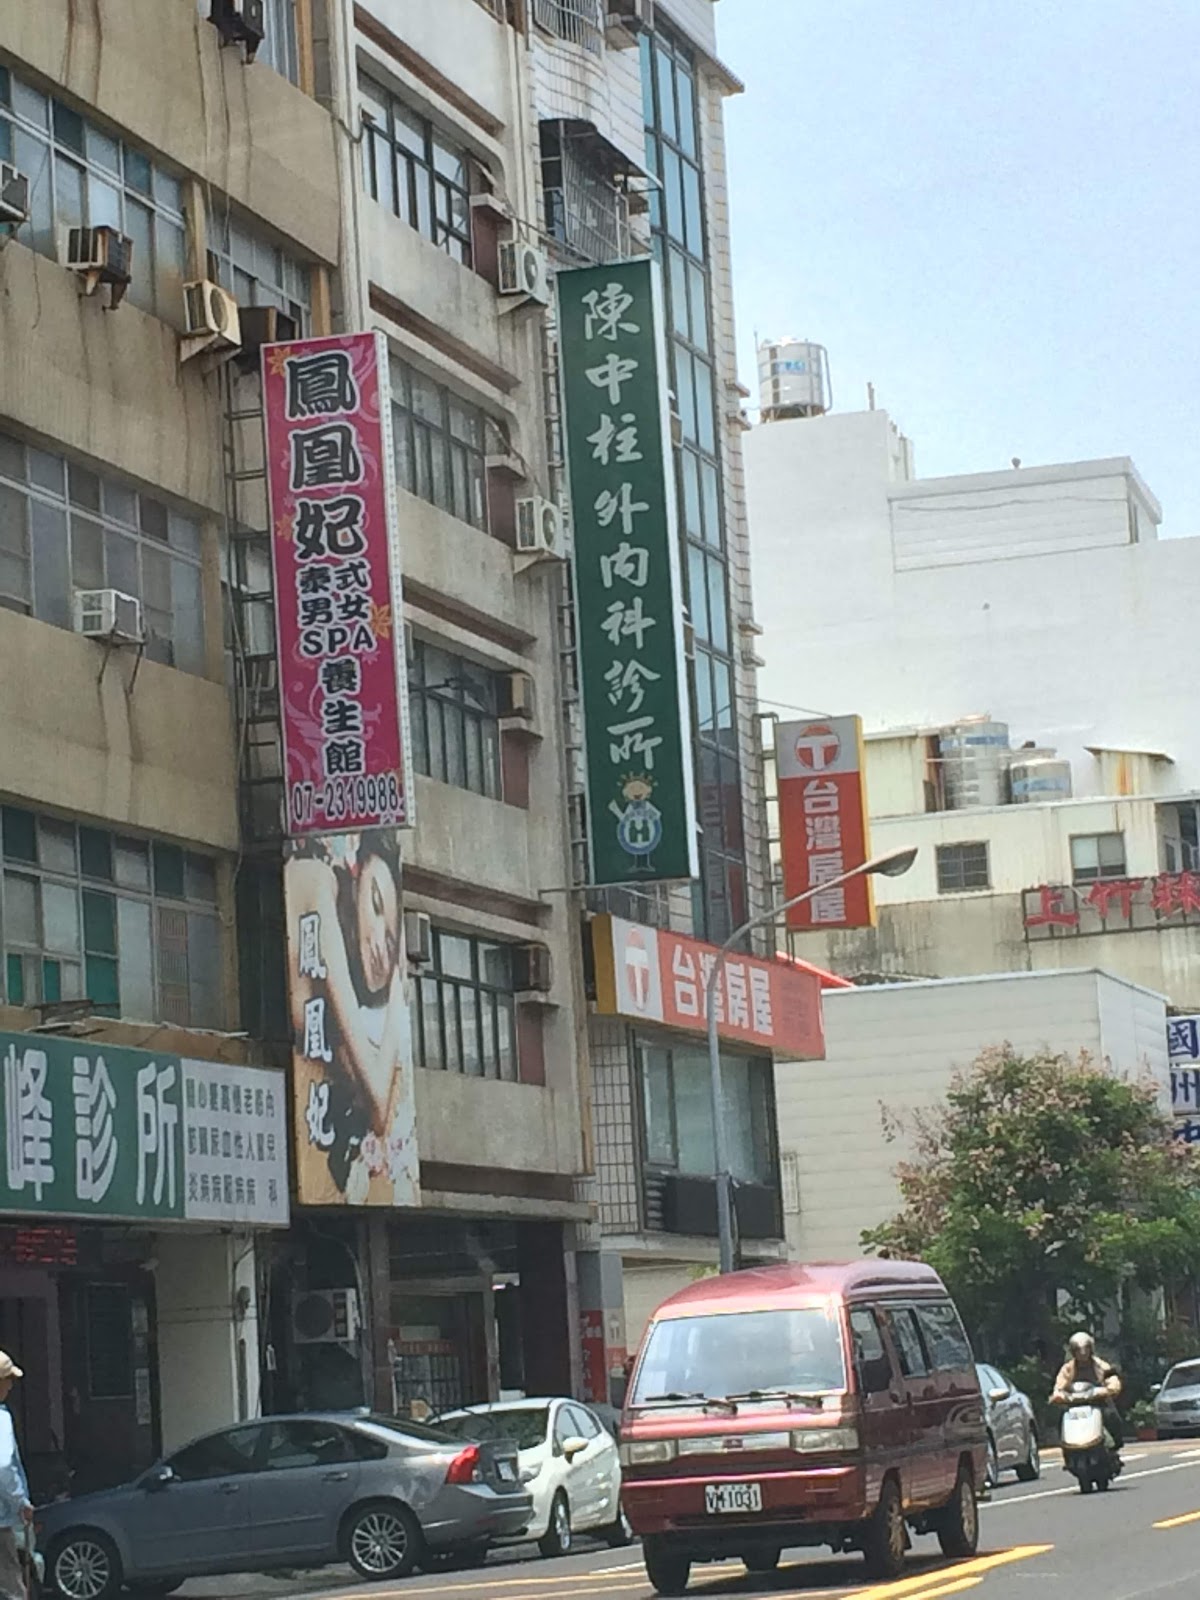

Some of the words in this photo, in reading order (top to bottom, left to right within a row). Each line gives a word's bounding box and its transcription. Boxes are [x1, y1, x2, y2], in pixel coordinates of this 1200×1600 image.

[287, 351, 366, 560] 鳳凰妃
[300, 560, 368, 595] 泰式
[301, 594, 369, 627] 男女
[302, 625, 374, 656] SPA
[321, 658, 364, 775] 養生館
[294, 775, 398, 820] 07-2319988
[803, 779, 846, 923] 台灣房屋
